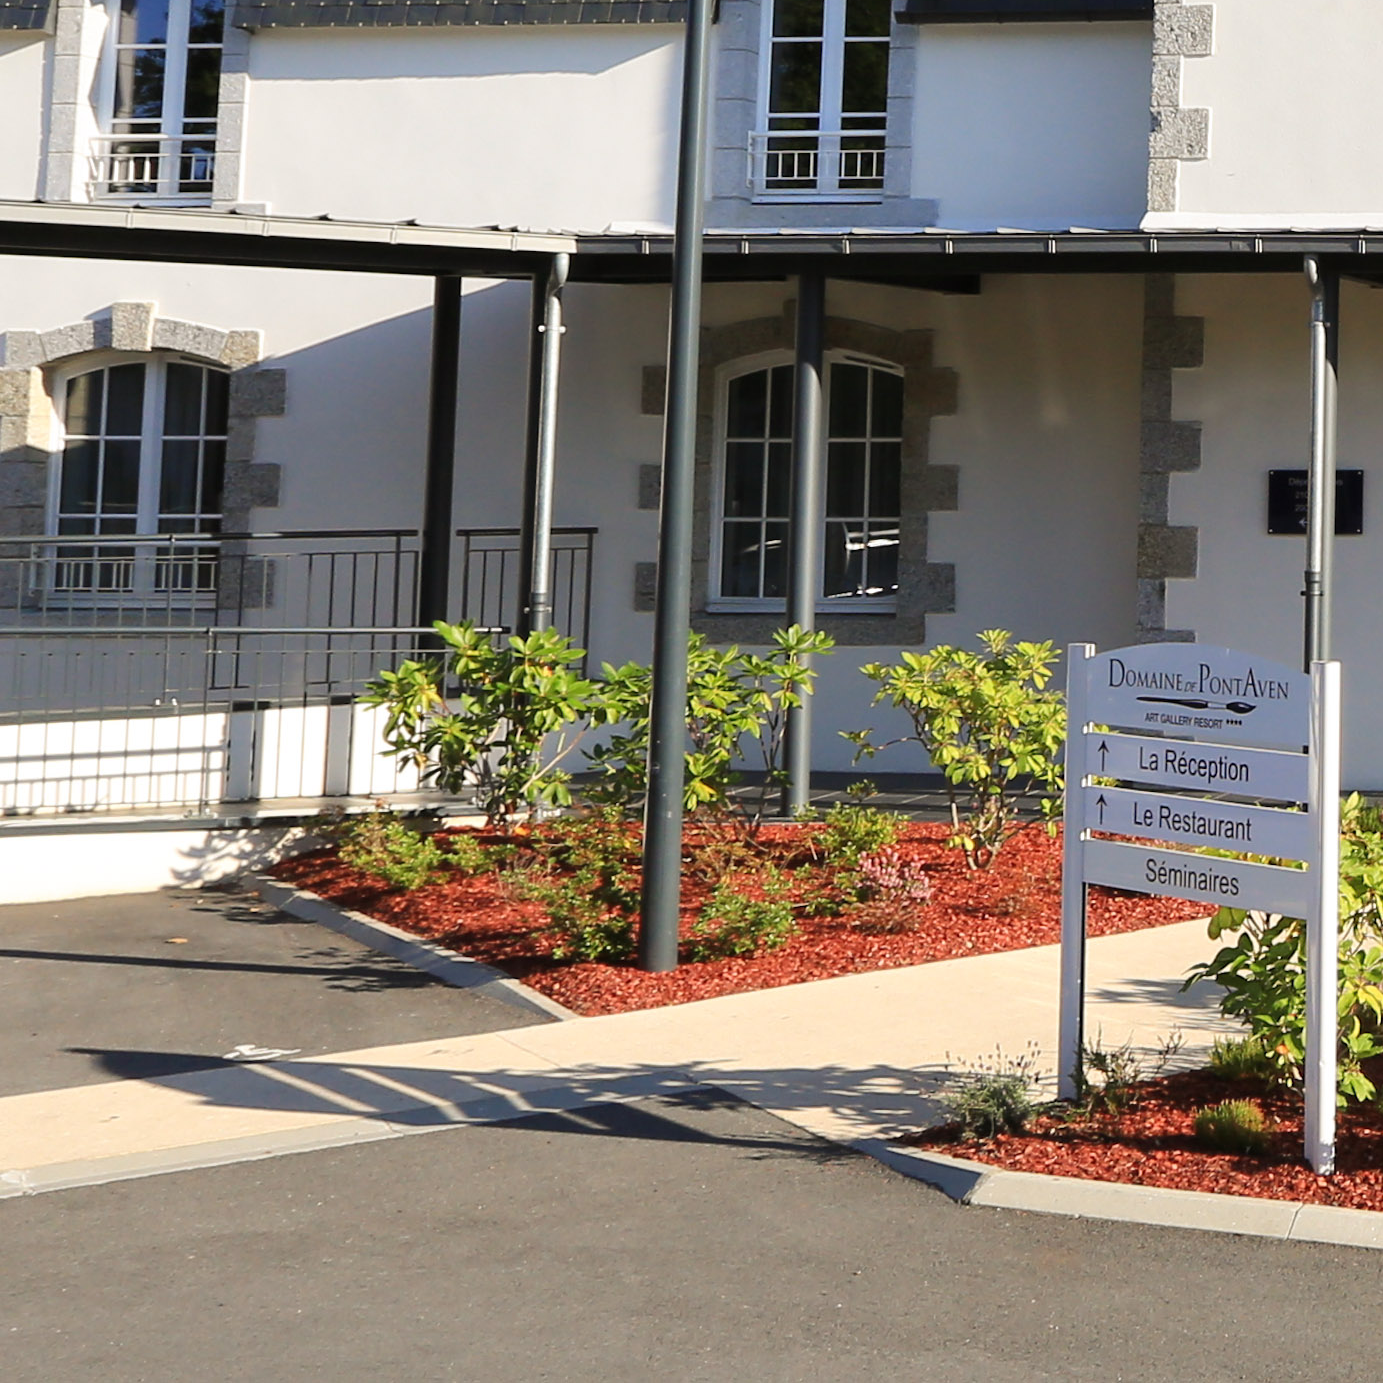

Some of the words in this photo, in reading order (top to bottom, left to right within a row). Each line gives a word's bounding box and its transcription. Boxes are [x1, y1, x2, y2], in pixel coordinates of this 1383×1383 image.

[1145, 712, 1158, 722] ART
[1160, 714, 1193, 727] GALLERY
[1194, 718, 1223, 730] RESORT
[1139, 746, 1159, 771] La
[1164, 749, 1250, 784] Réception
[1133, 801, 1154, 827] Le
[1159, 805, 1252, 842] Restaurant
[1145, 858, 1240, 897] Séminaires
